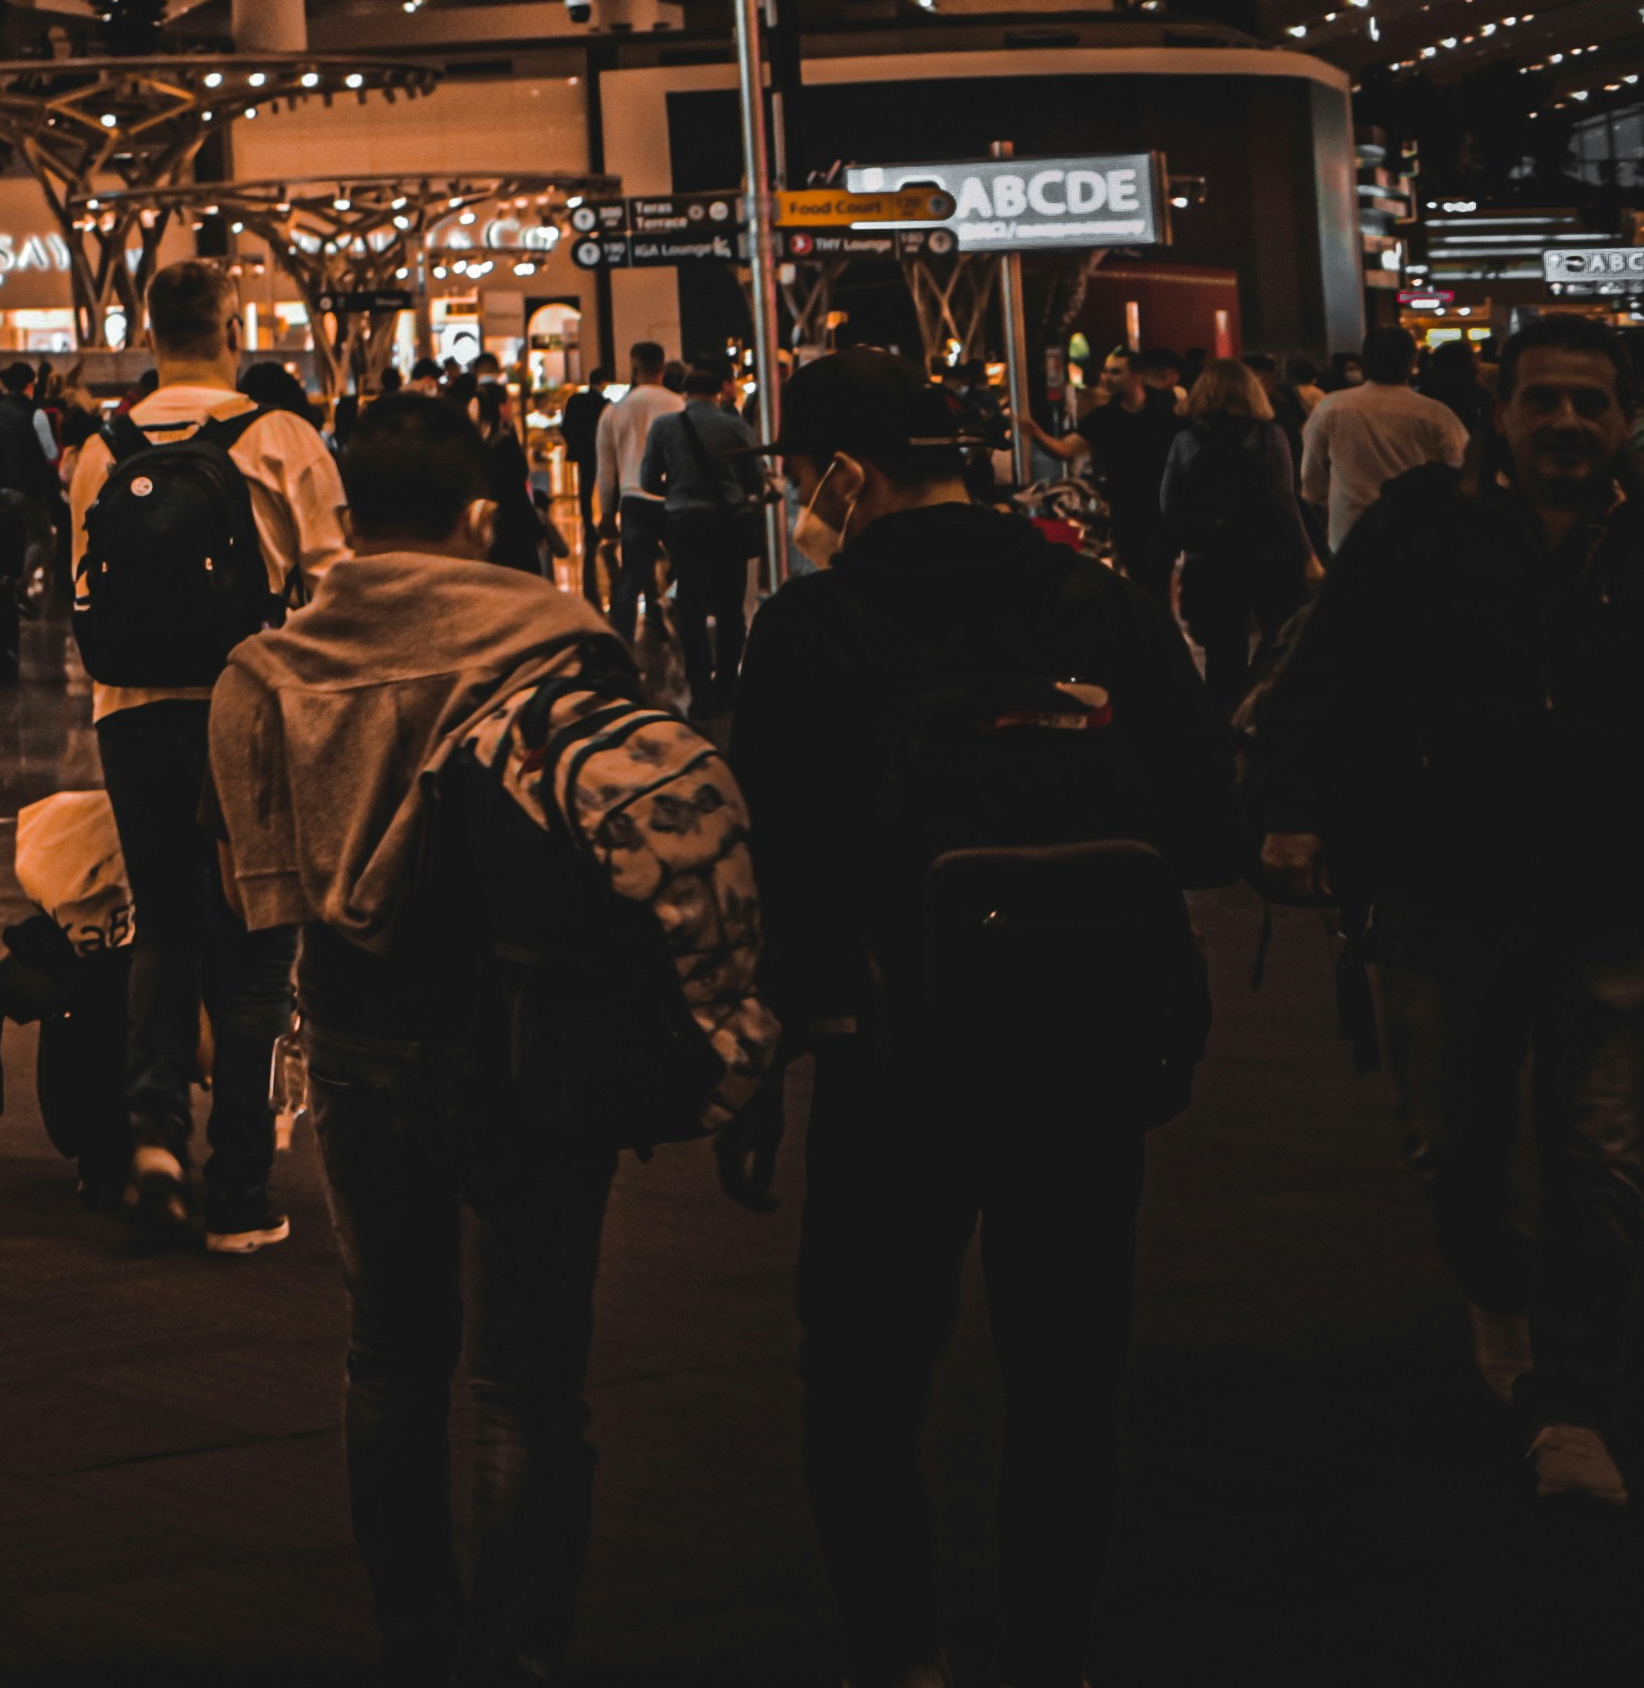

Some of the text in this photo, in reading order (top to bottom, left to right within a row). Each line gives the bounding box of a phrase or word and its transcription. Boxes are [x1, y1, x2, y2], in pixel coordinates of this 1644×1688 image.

[790, 199, 881, 214] Food Court
[957, 169, 1139, 218] ABCDE
